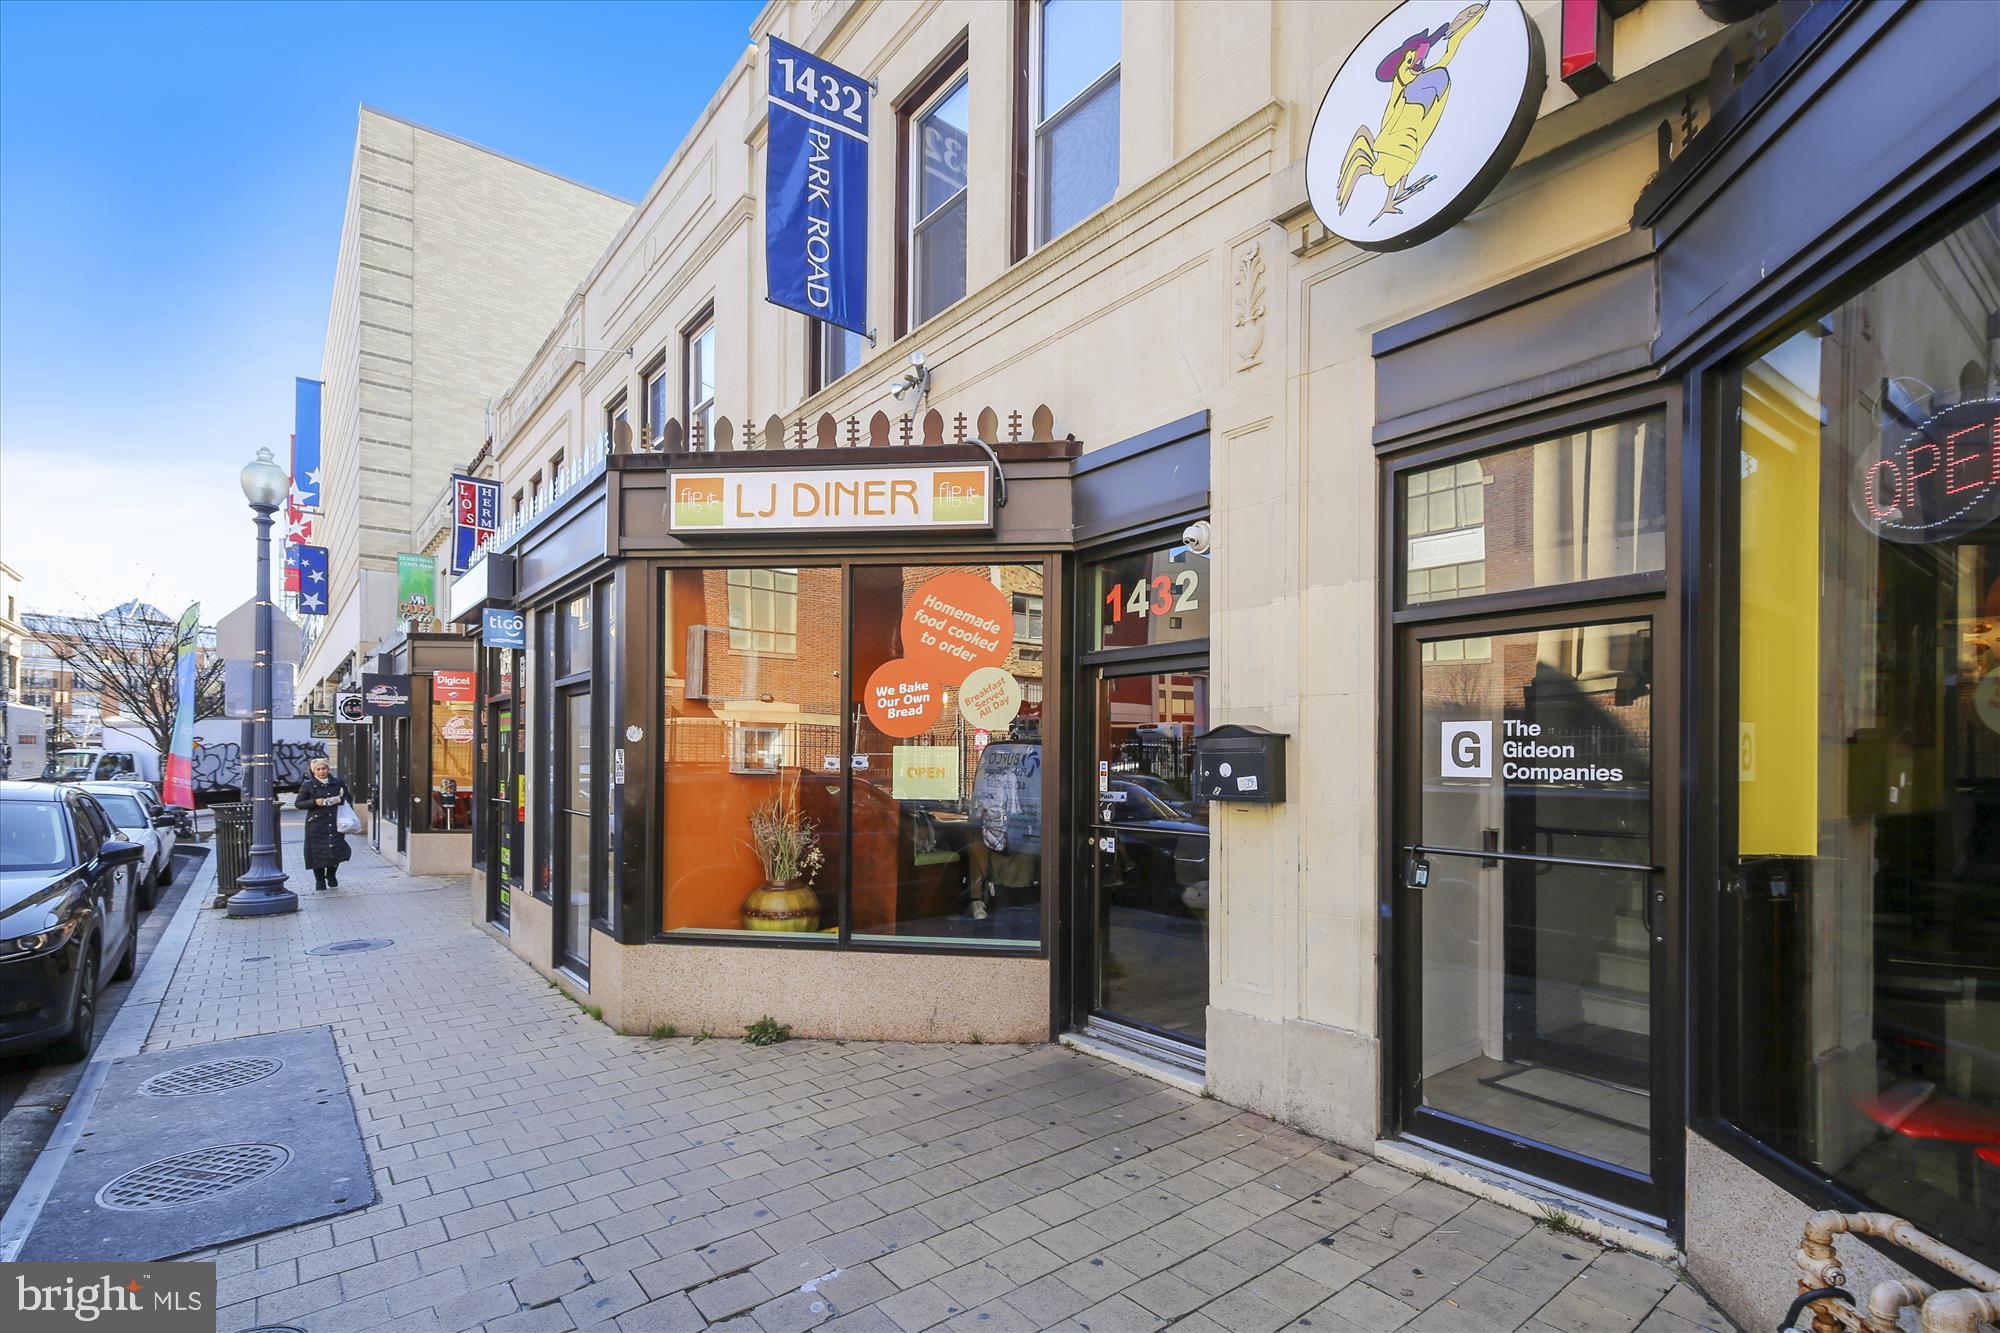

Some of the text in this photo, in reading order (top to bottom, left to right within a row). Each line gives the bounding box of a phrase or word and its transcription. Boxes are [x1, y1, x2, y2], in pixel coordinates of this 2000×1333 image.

[776, 58, 863, 124] 1432
[807, 128, 831, 308] PARK ROAD
[1865, 416, 2000, 516] OPE
[460, 484, 475, 523] LOS
[736, 479, 919, 517] LJ DINER
[1106, 570, 1199, 622] 1432
[922, 594, 1001, 634] Homemade
[913, 609, 999, 652] food cooked
[920, 631, 978, 662] to order
[437, 675, 470, 686] Digicel
[876, 681, 929, 697] We Bake
[964, 677, 1006, 707] Breakfast
[877, 693, 931, 709] Our Own
[887, 704, 923, 719] Bread
[975, 689, 1005, 711] Served
[979, 696, 1010, 718] All Day
[1502, 719, 1541, 737] The
[1451, 730, 1481, 768] G
[1502, 741, 1575, 758] Gideon
[906, 767, 945, 779] OPEN
[1502, 762, 1623, 783] Companies
